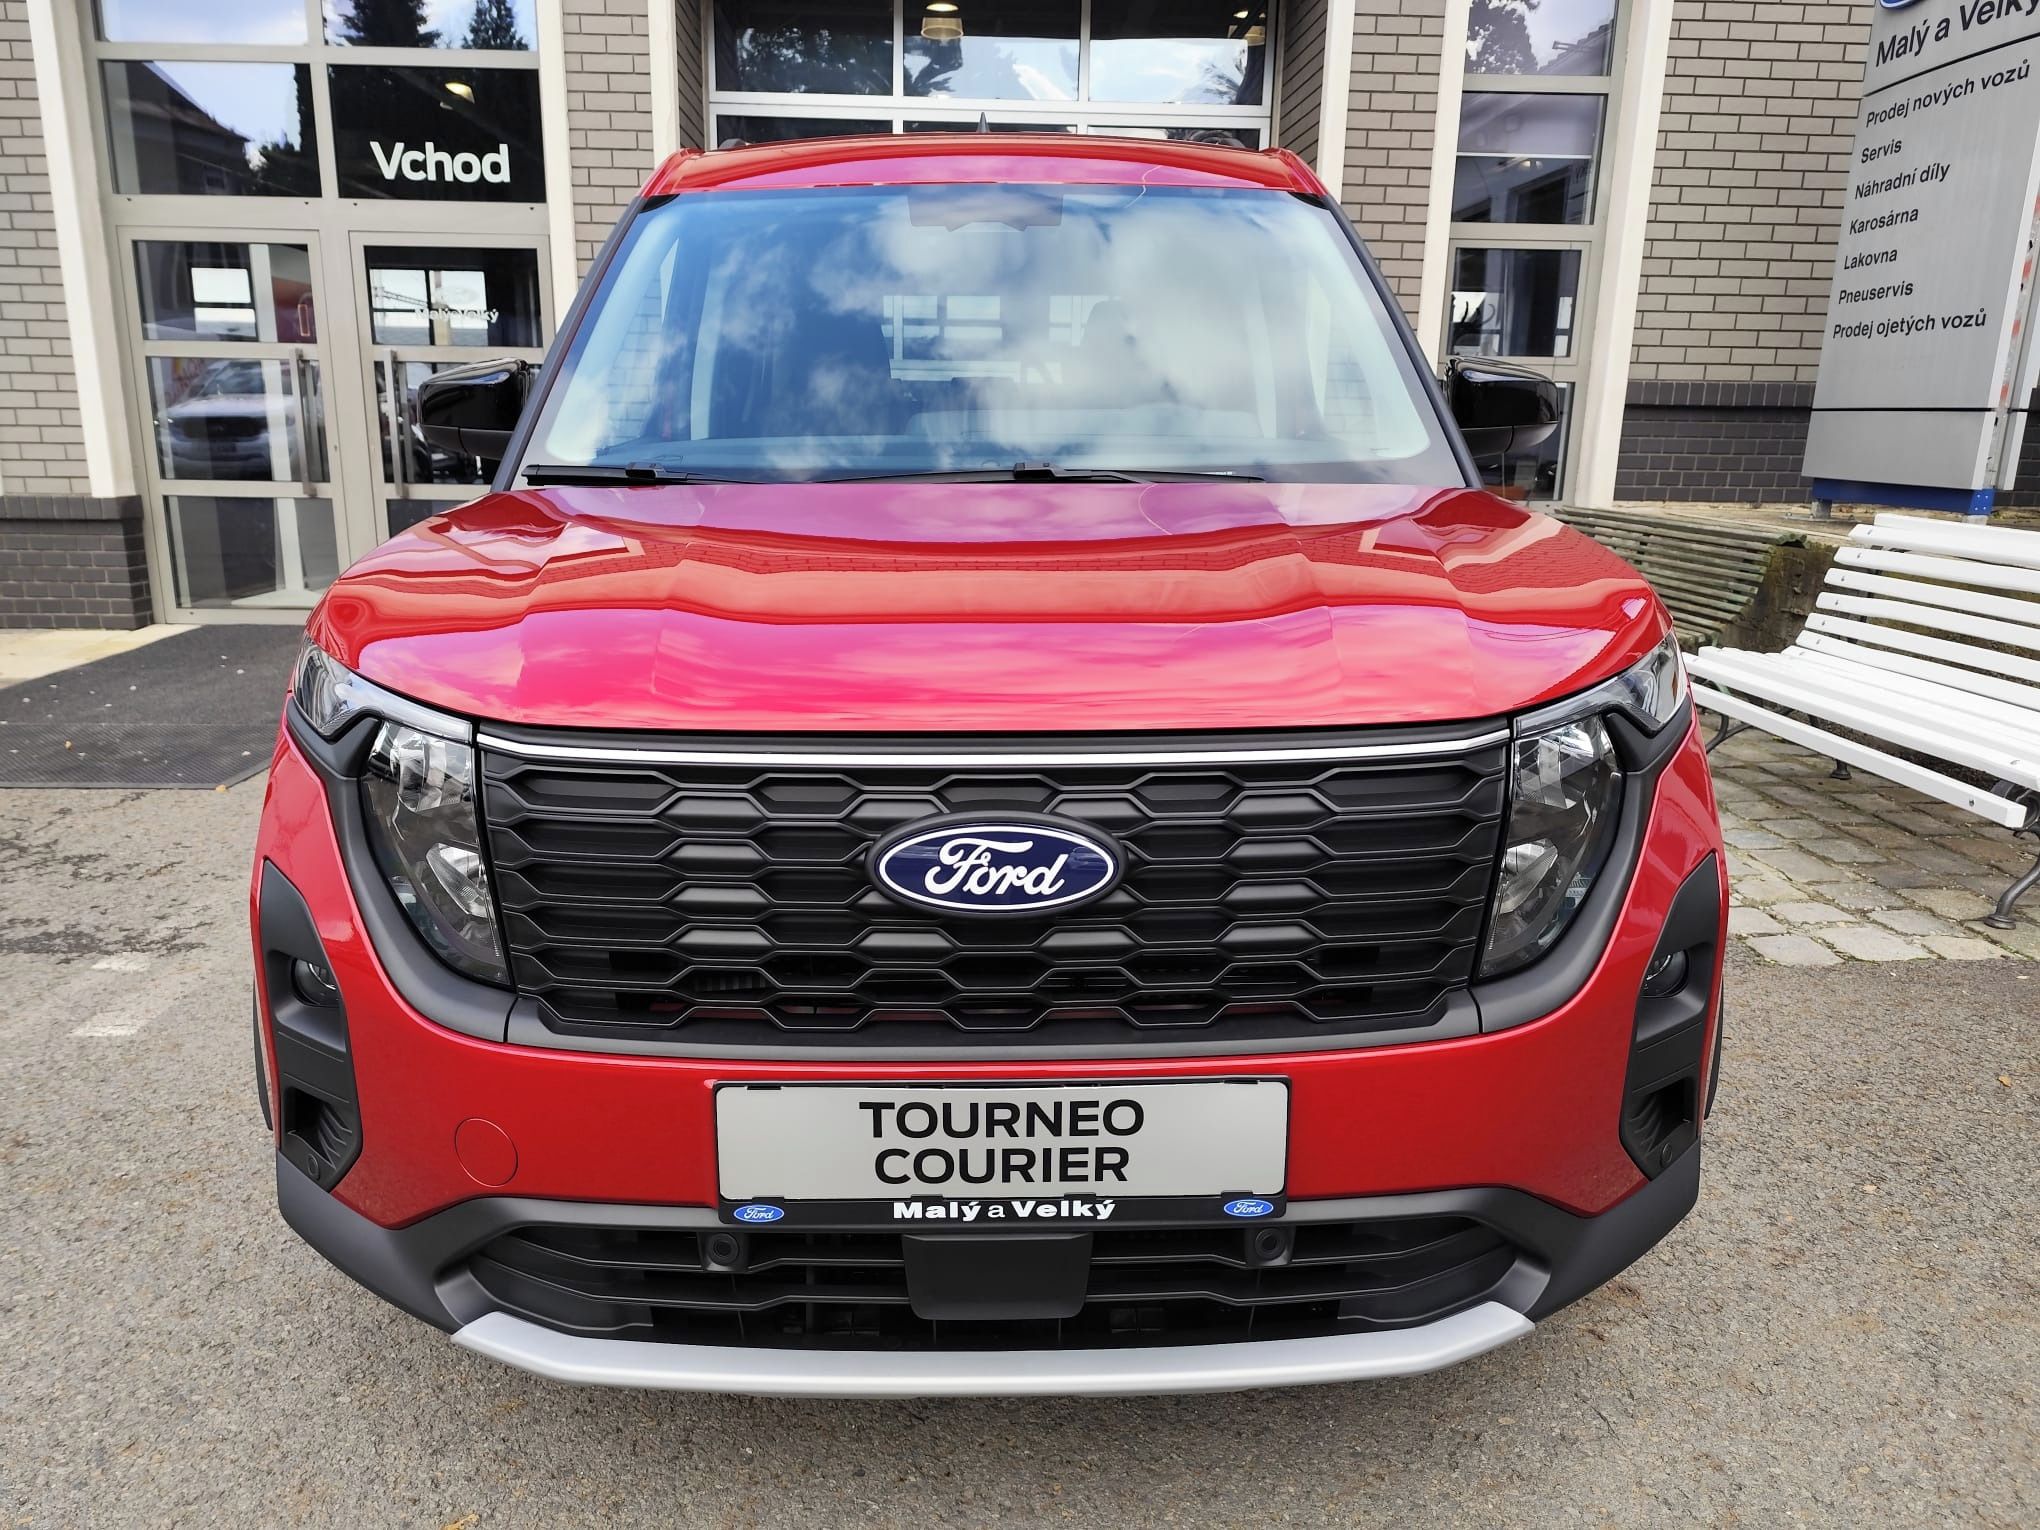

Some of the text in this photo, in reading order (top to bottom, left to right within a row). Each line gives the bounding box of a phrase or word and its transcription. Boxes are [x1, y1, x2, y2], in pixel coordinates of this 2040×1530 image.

[1875, 19, 1930, 67] Malý
[1934, 18, 1950, 42] a
[1866, 58, 2030, 128] Prodej nových vozů
[369, 140, 511, 183] Vchod
[1861, 139, 1903, 164] Servis
[1855, 163, 1951, 200] Náhradní díly
[1849, 207, 1919, 235] Karosárna
[1844, 249, 1898, 270] Lakovna
[1838, 280, 1914, 304] Pneuservis
[1833, 307, 1987, 339] Prodej ojetých vozů
[924, 837, 1069, 895] Ford
[859, 1099, 1145, 1138] TOURNEO
[874, 1146, 1130, 1184] COURIER
[743, 1207, 775, 1219] Ford
[893, 1199, 1116, 1221] Malý a Velký
[1233, 1201, 1264, 1214] Ford
